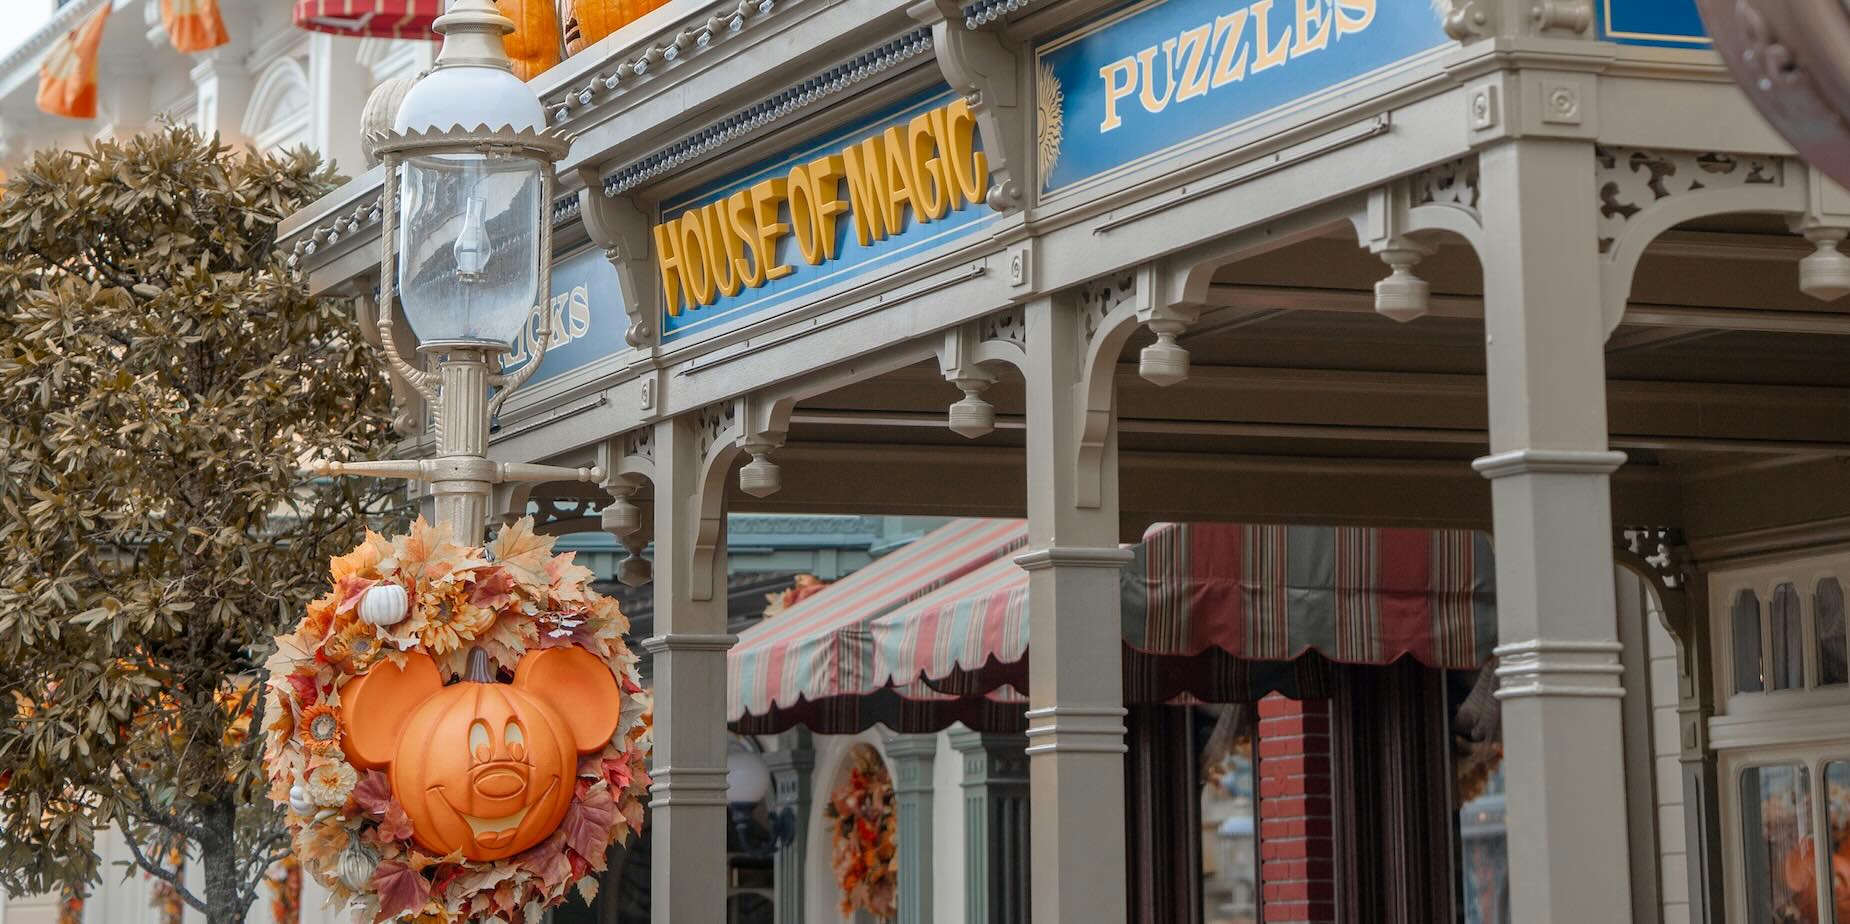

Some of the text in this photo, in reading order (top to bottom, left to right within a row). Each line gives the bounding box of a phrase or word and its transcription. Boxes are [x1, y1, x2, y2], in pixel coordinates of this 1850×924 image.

[1100, 0, 1377, 133] PUZZLES
[653, 98, 988, 317] HOUSE OF MAGIC
